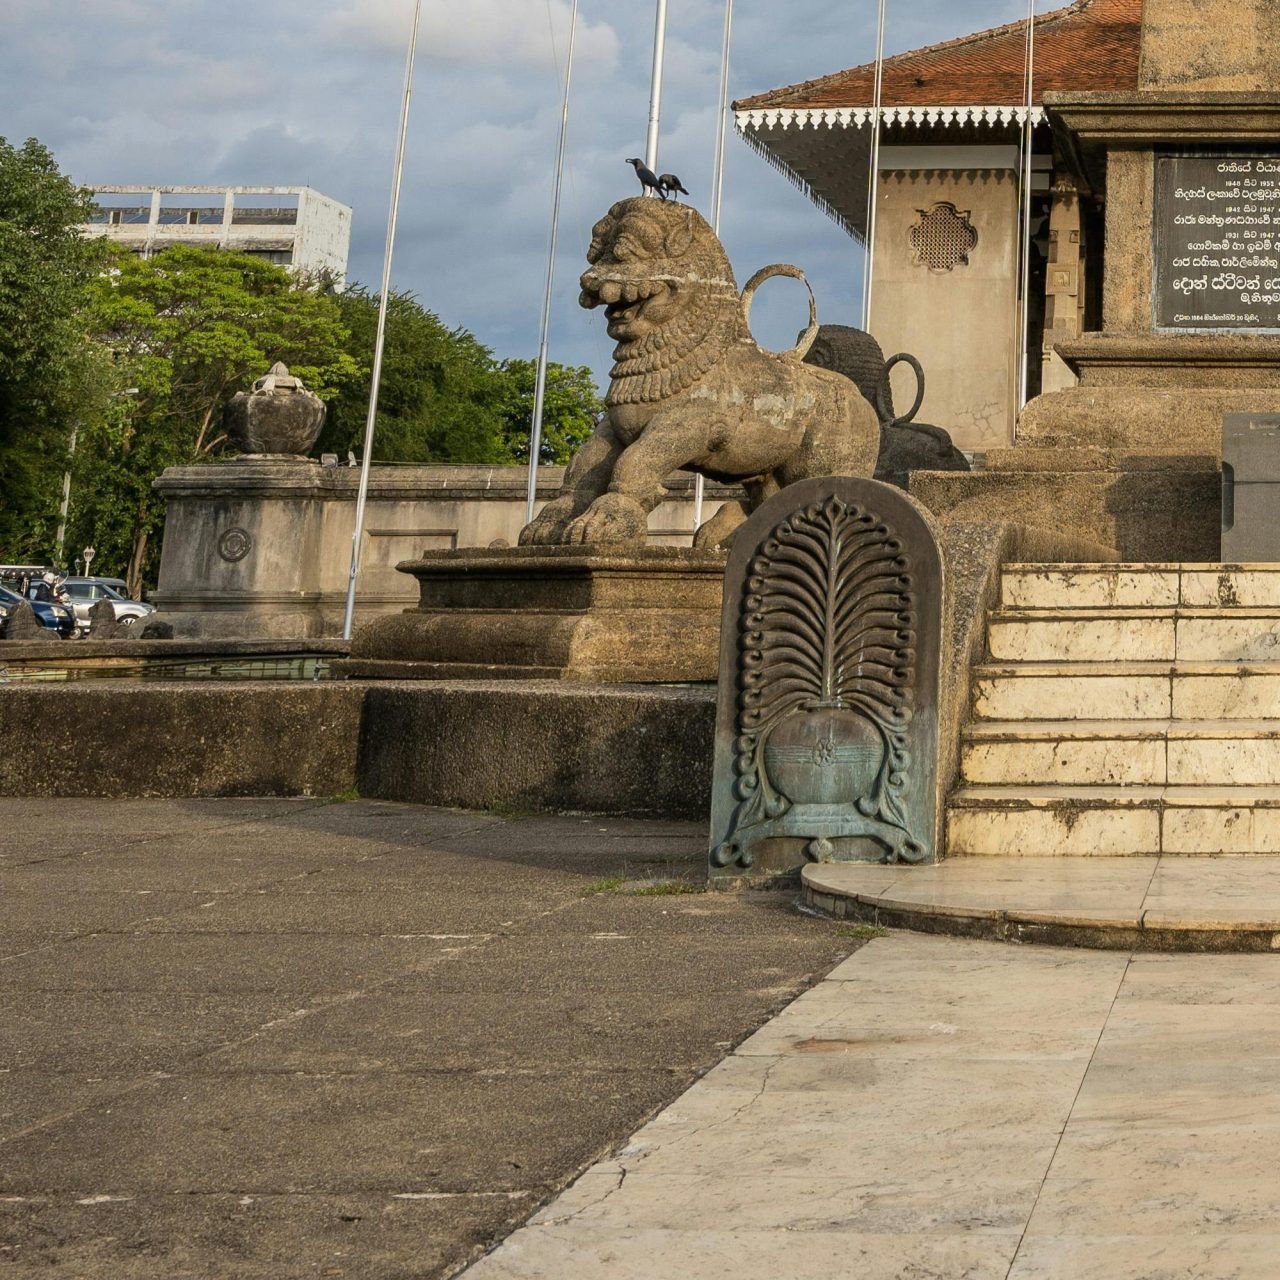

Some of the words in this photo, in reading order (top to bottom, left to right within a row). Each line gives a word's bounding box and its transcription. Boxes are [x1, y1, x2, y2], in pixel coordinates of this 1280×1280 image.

[1175, 187, 1205, 199] නිදහස්
[1188, 240, 1230, 250] ගොවිකම්
[1247, 240, 1271, 253] ඉඩම්
[1173, 257, 1190, 266] රාජ
[1173, 275, 1207, 295] දොන්
[1211, 273, 1260, 290] ස්ටීවන්
